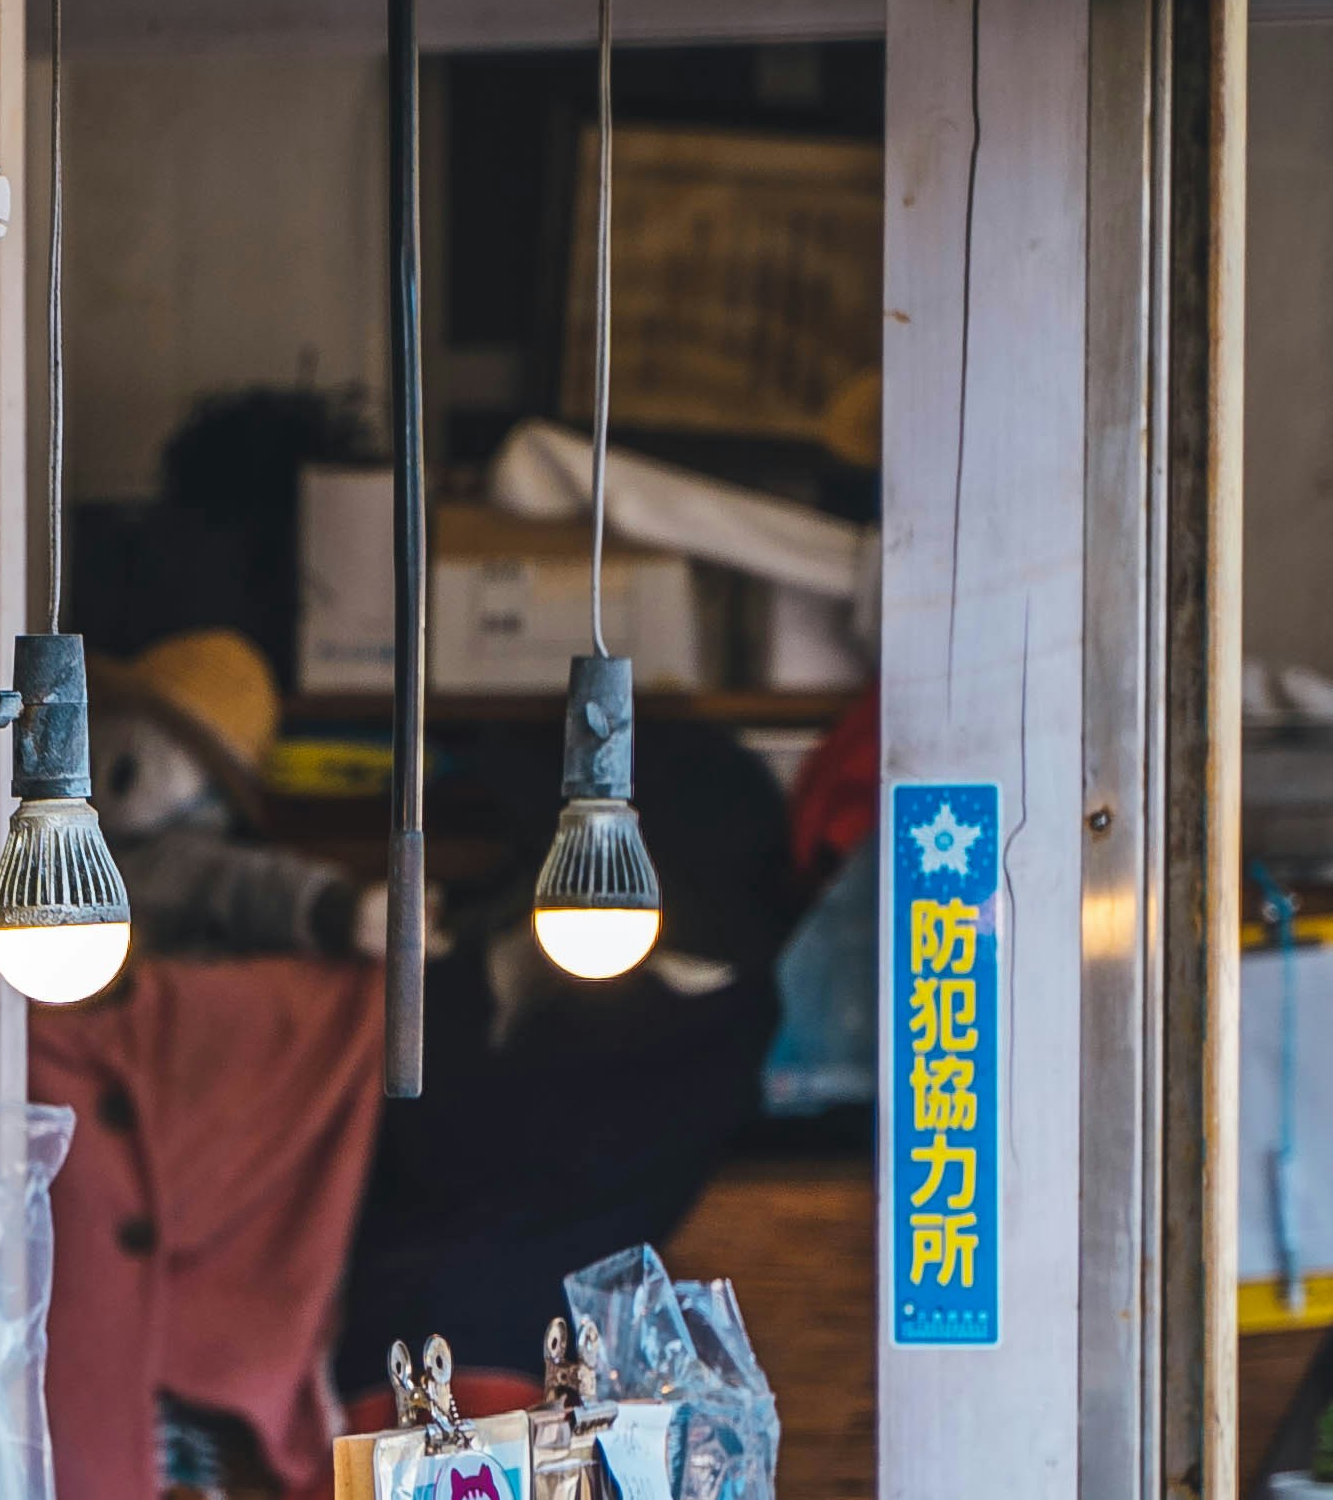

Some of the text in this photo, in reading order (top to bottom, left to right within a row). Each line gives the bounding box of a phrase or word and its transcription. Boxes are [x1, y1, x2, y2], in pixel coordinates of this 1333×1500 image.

[909, 897, 980, 1288] 防犯協力所
